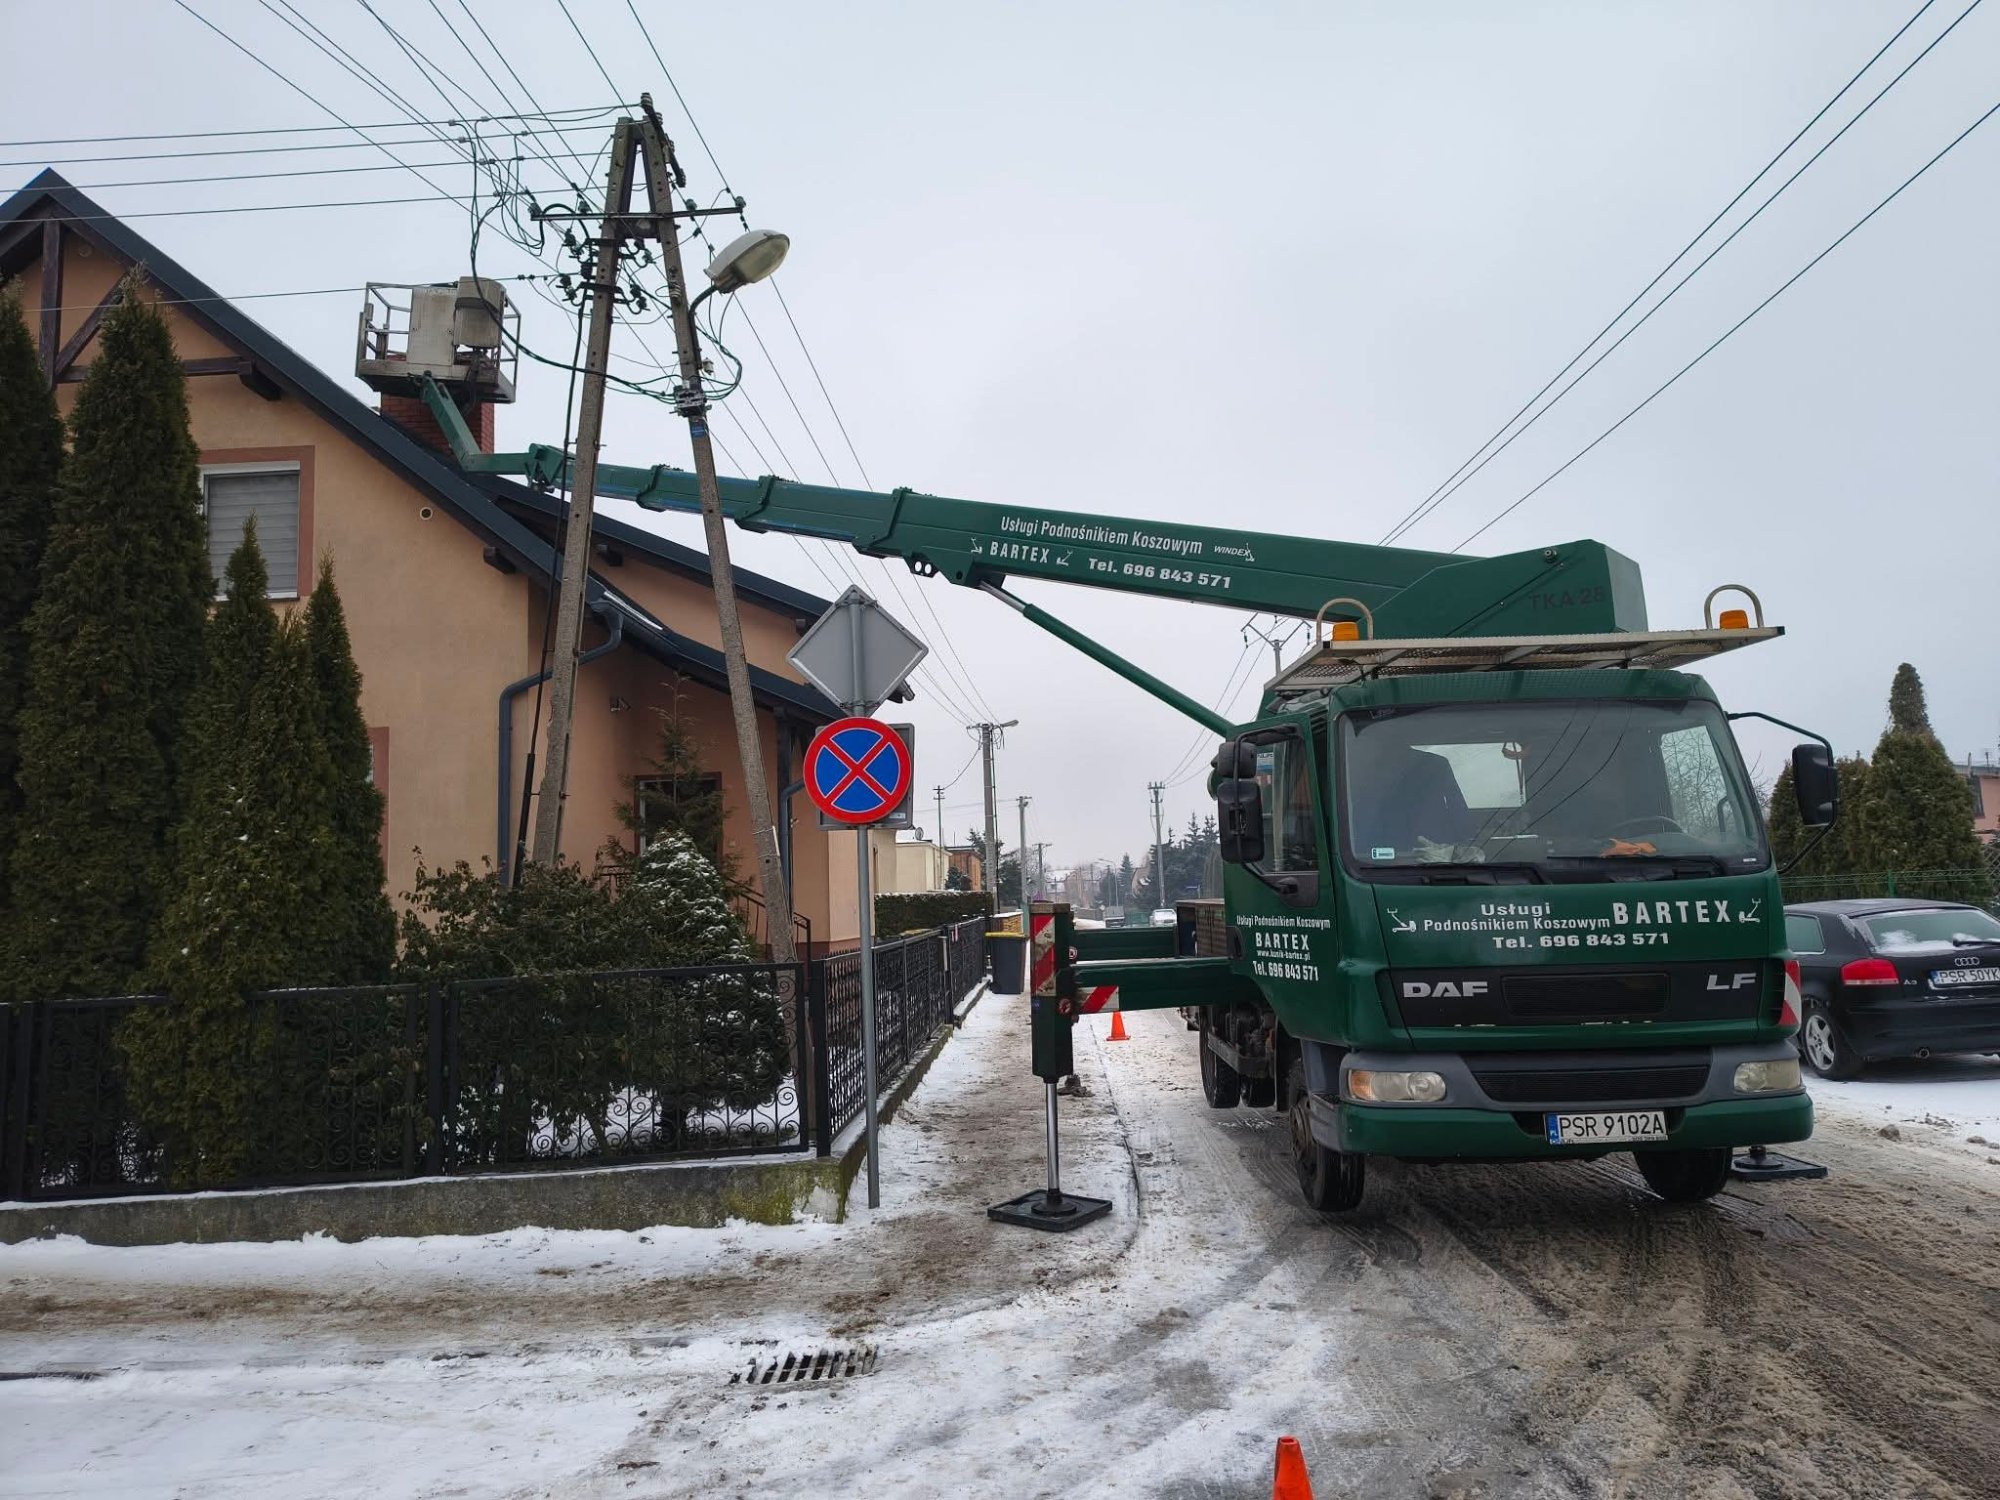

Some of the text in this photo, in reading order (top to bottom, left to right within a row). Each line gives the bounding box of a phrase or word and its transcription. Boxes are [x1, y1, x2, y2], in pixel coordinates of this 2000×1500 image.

[1000, 516, 1202, 555] Usługi Podnośnikiem Koszowym
[989, 541, 1050, 564] BARTEX
[1213, 545, 1250, 557] WINDEX
[1088, 557, 1231, 589] Tel. 696 843 571
[1481, 902, 1551, 917] Usługi
[1612, 900, 1731, 926] BARTEX
[1236, 915, 1254, 927] Usługi
[1296, 916, 1331, 930] Koszowym
[1424, 915, 1610, 932] Podnośnikiem Koszowym
[1255, 932, 1310, 950] BARTEX
[1492, 931, 1669, 950] Tel. 696 843 571
[1253, 960, 1319, 981] Tel. 696 843 571
[1940, 970, 1967, 982] PSR
[1402, 981, 1488, 998] DAF
[1706, 973, 1757, 990] LF
[1559, 1113, 1664, 1137] PSR 9102A
